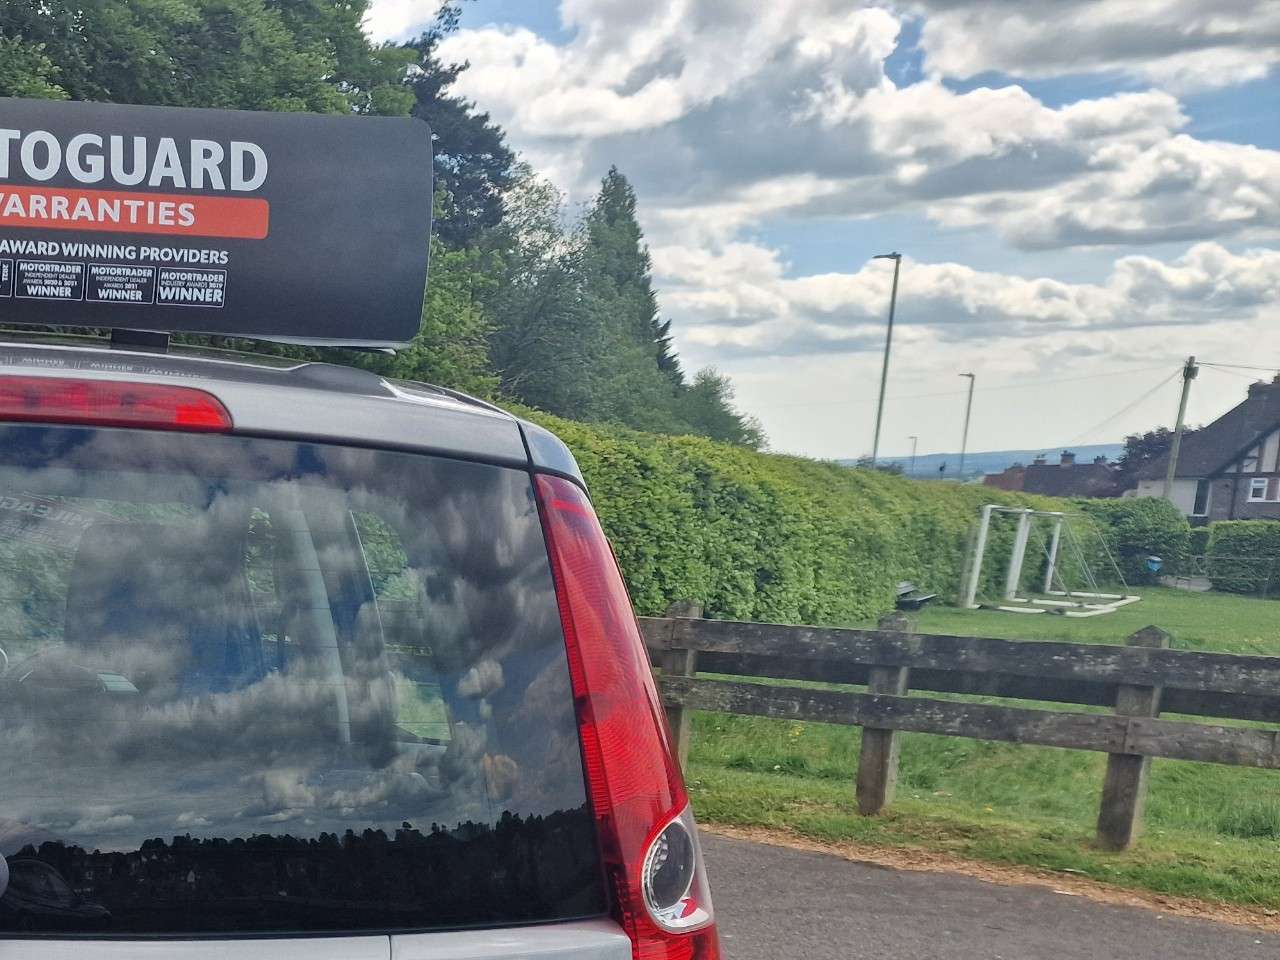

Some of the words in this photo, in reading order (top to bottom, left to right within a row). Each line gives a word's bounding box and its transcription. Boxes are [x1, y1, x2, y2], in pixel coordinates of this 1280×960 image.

[61, 241, 136, 260] WINNING
[140, 246, 229, 264] PROVIDERS
[20, 262, 82, 274] MOTORTRADER
[91, 266, 153, 278] MOTORTRADER
[161, 271, 224, 283] MOTORTRADER
[26, 284, 72, 298] WINNER
[98, 288, 143, 301] WINNER
[159, 286, 223, 303] WINNER
